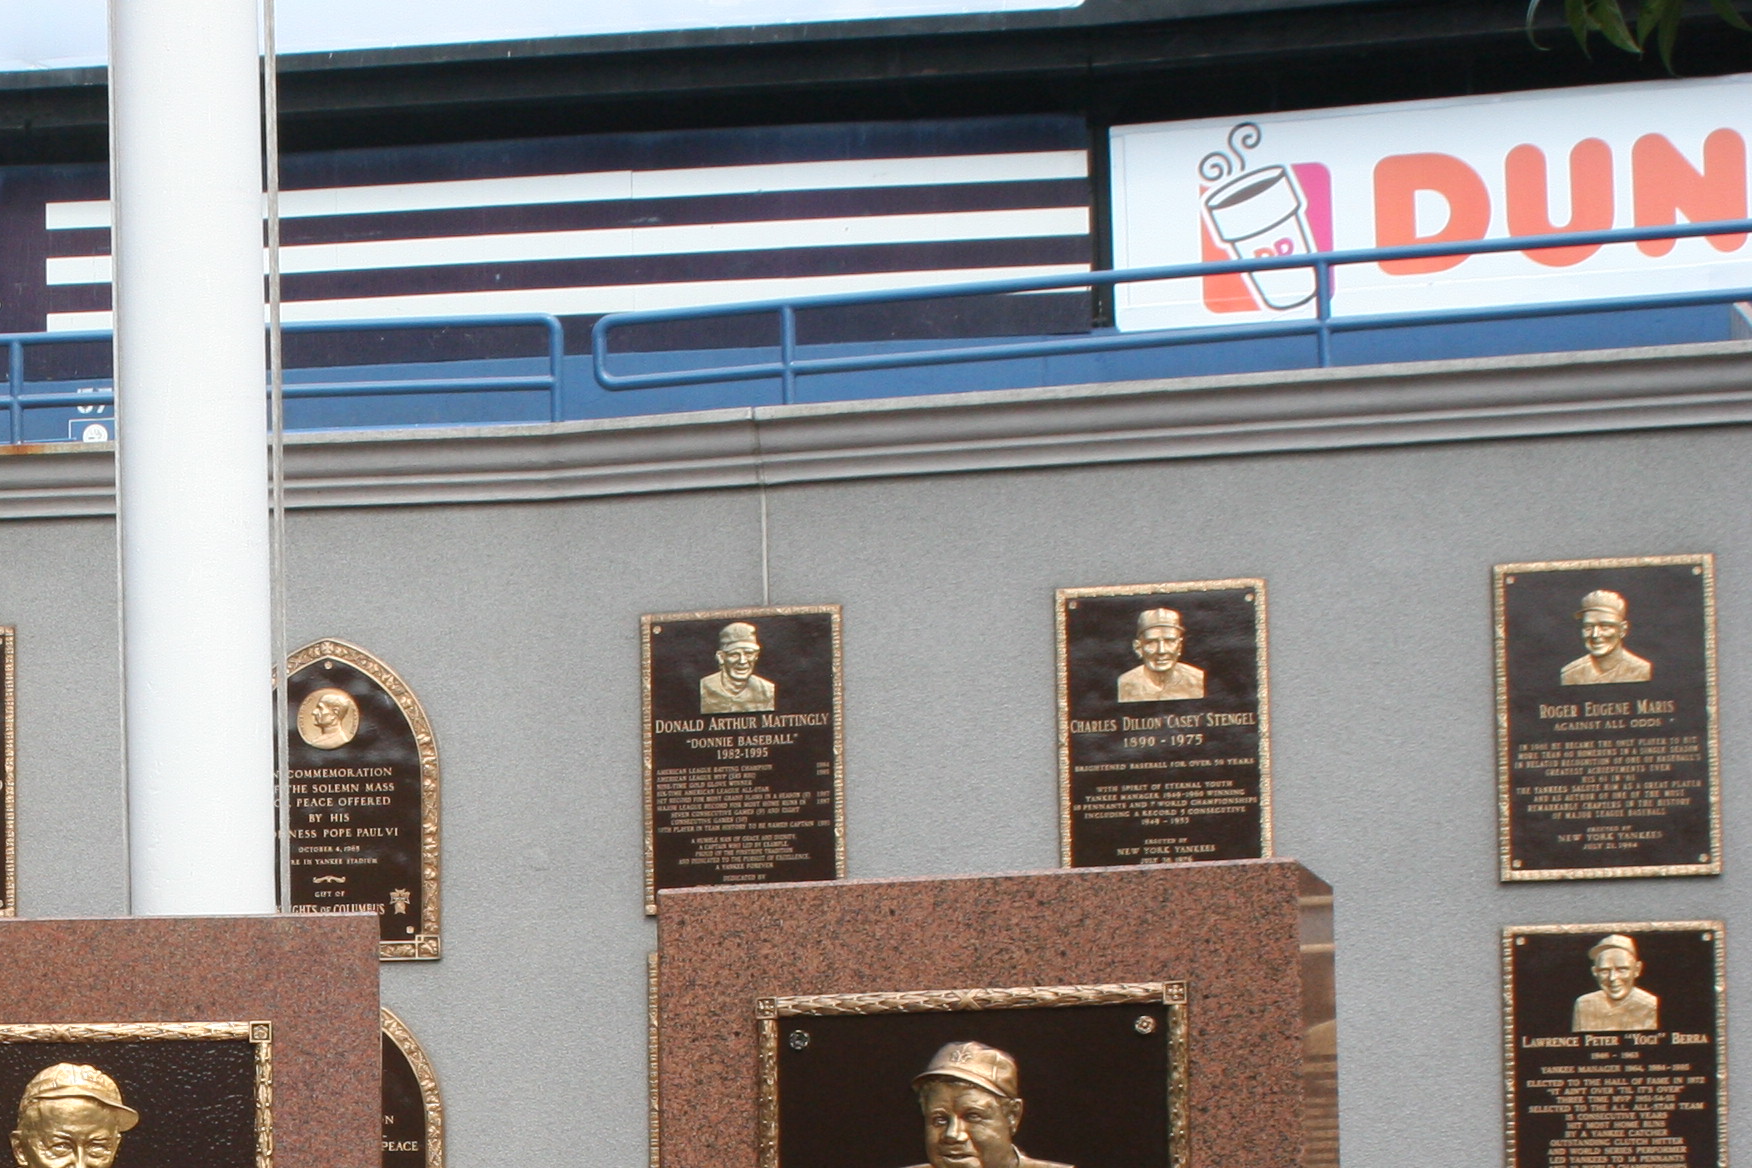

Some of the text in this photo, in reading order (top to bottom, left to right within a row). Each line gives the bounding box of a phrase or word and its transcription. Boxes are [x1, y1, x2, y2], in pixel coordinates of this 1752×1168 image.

[1540, 699, 1674, 718] ROGER EUGENE MARIS
[656, 713, 829, 733] DONALD ARTHUR MATTINGLY
[1071, 719, 1117, 734] CHARLES
[1123, 716, 1162, 731] DILLON
[1206, 712, 1255, 726] STENGEL
[1554, 718, 1663, 731] AGAINST ALL ODDS
[288, 767, 392, 779] COMMEMORATION
[289, 783, 394, 794] HE SOLEMN MASS
[297, 797, 390, 807] PEACE OFFERED
[309, 813, 349, 822] BY HIS
[324, 828, 398, 837] POPE PAUL VI
[1523, 1036, 1580, 1048] LAWRENCE
[1585, 1035, 1619, 1046] PETER
[1672, 1032, 1709, 1044] BERRA
